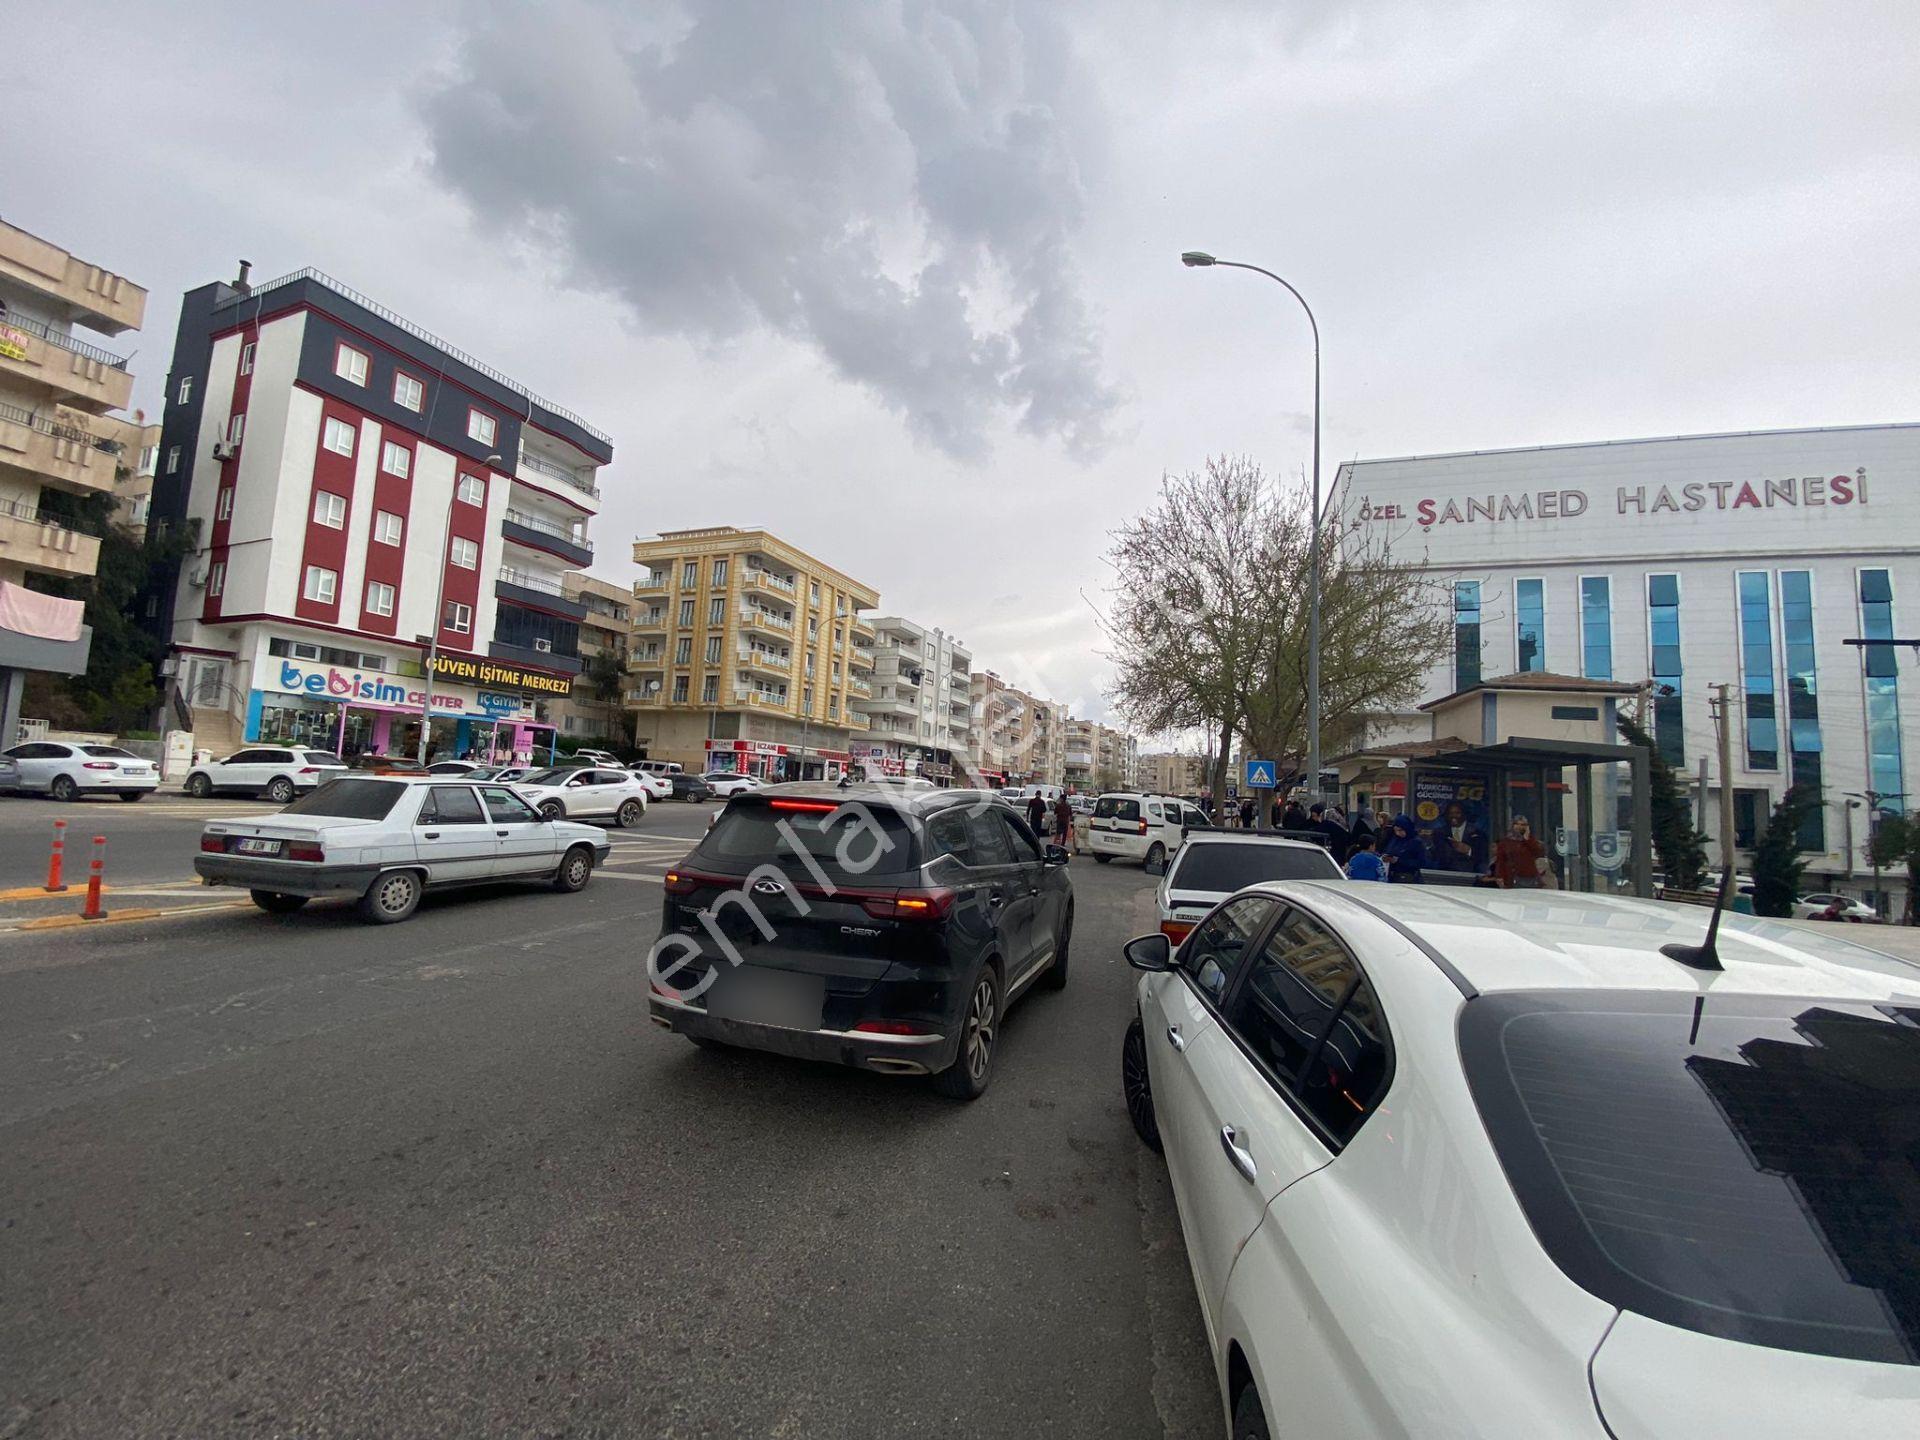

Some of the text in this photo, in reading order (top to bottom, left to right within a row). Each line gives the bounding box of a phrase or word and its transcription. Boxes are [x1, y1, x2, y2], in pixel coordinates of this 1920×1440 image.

[1359, 467, 1869, 533] ÖZEL ŞANMED HASTANESİ
[280, 660, 463, 709] bebisim CENTER
[426, 655, 570, 694] GÜVEN İŞİTME MERKEZİ
[840, 926, 882, 937] CHERY
